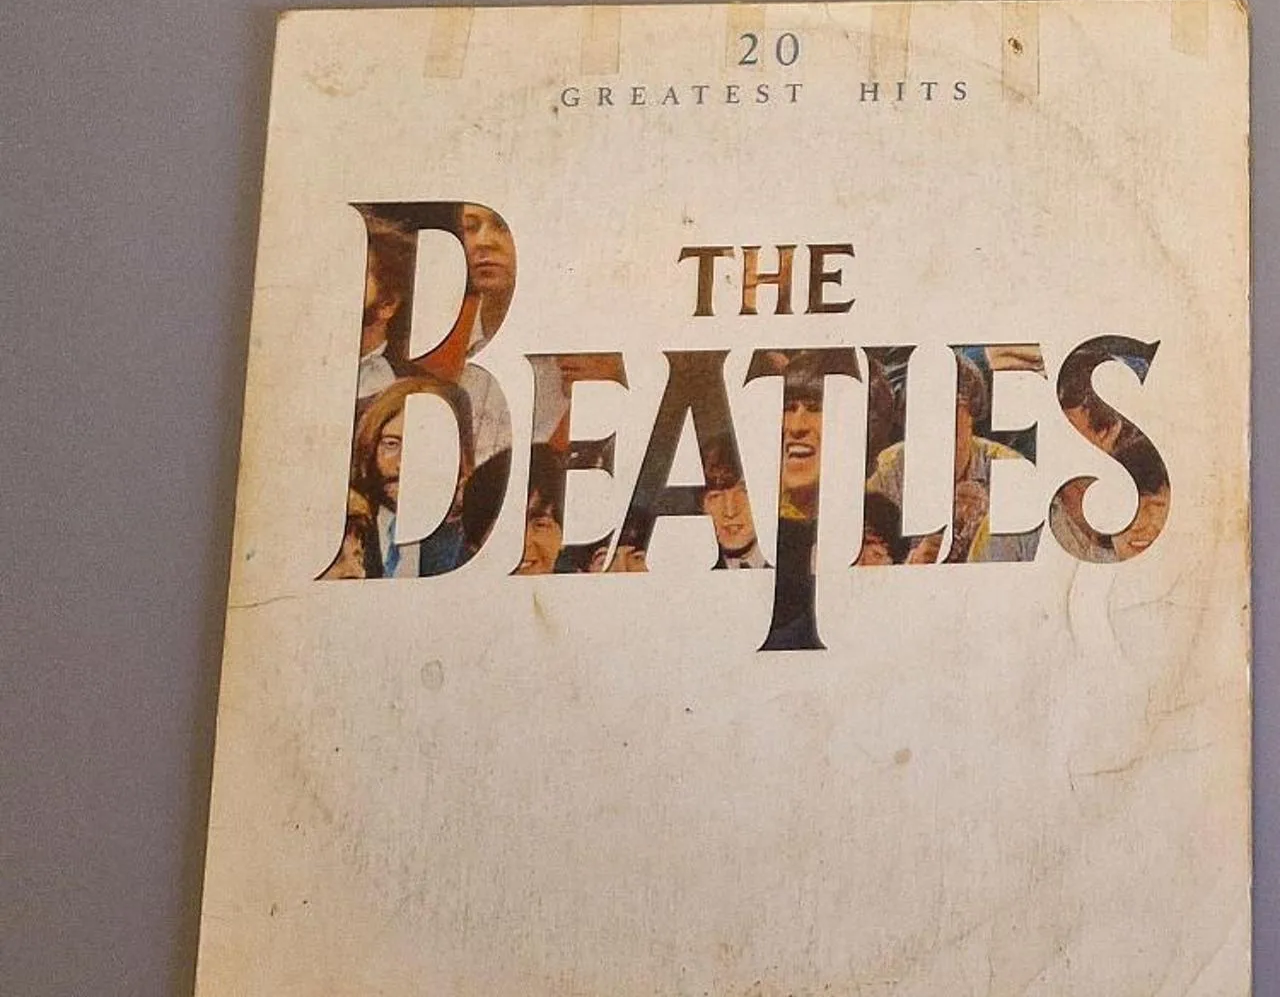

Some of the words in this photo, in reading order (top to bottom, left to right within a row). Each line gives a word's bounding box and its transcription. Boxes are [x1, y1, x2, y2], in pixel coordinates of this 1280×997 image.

[737, 31, 802, 67] 20
[560, 81, 804, 108] GREATEST
[859, 80, 968, 102] HITS
[677, 242, 857, 317] THE
[314, 199, 1173, 653] BEATLES
